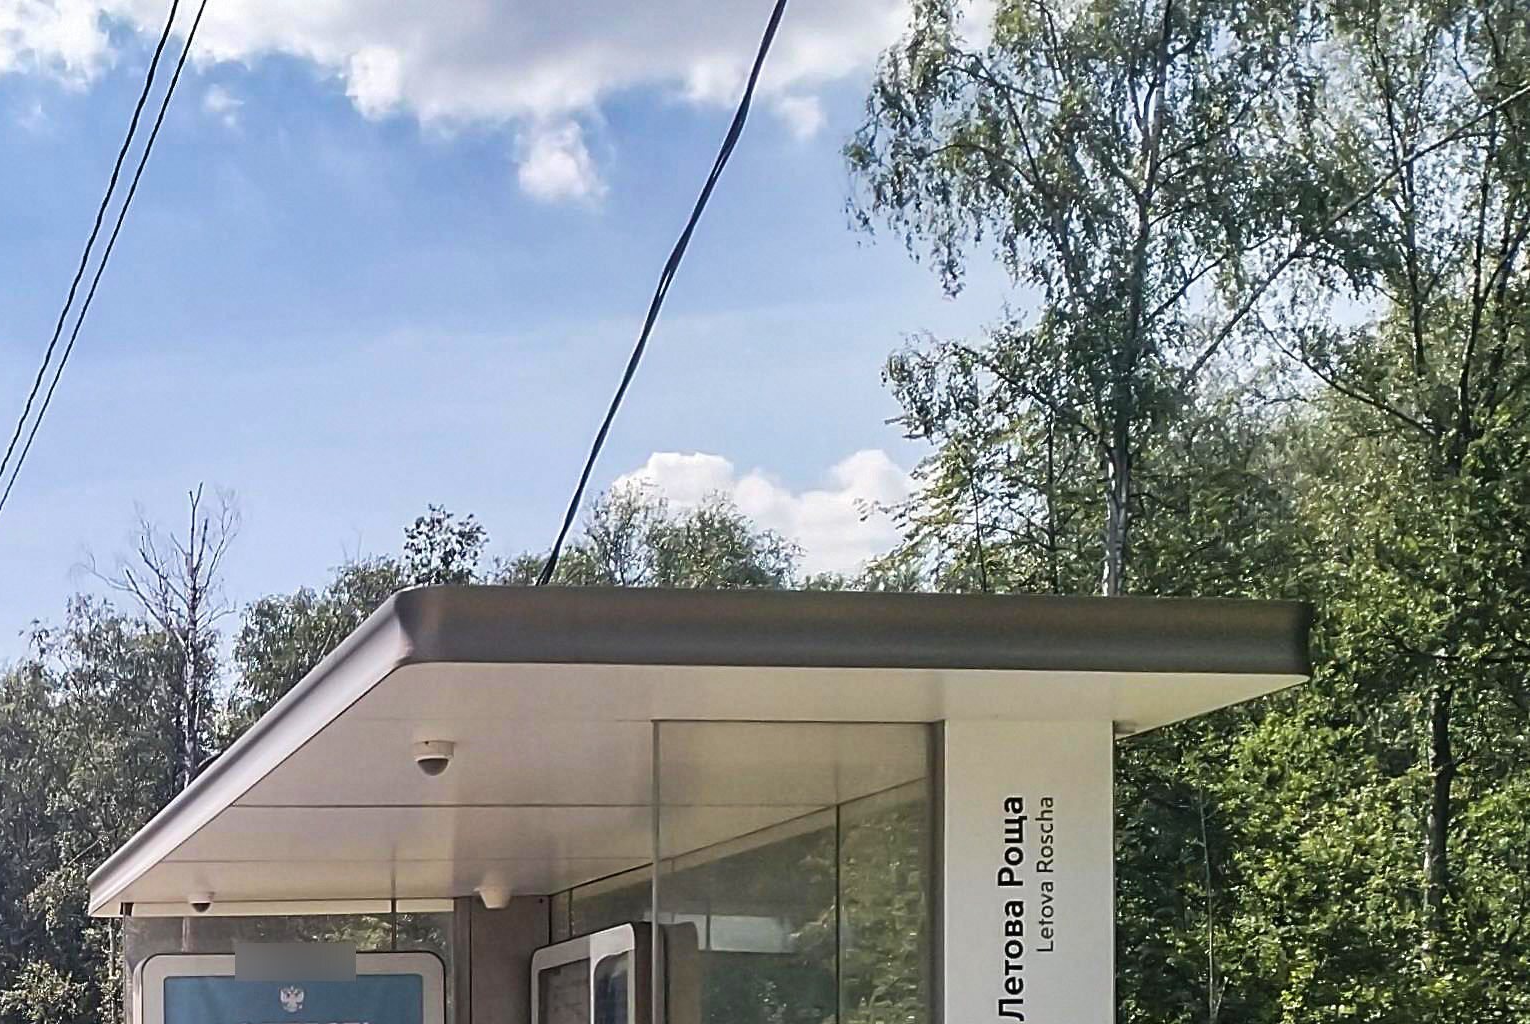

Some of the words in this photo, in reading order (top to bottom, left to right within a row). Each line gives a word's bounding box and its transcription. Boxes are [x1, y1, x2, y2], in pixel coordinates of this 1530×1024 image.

[997, 796, 1027, 887] Роща
[1035, 796, 1054, 873] Roscha
[1036, 881, 1054, 952] Letova
[998, 900, 1025, 1022] Летова
